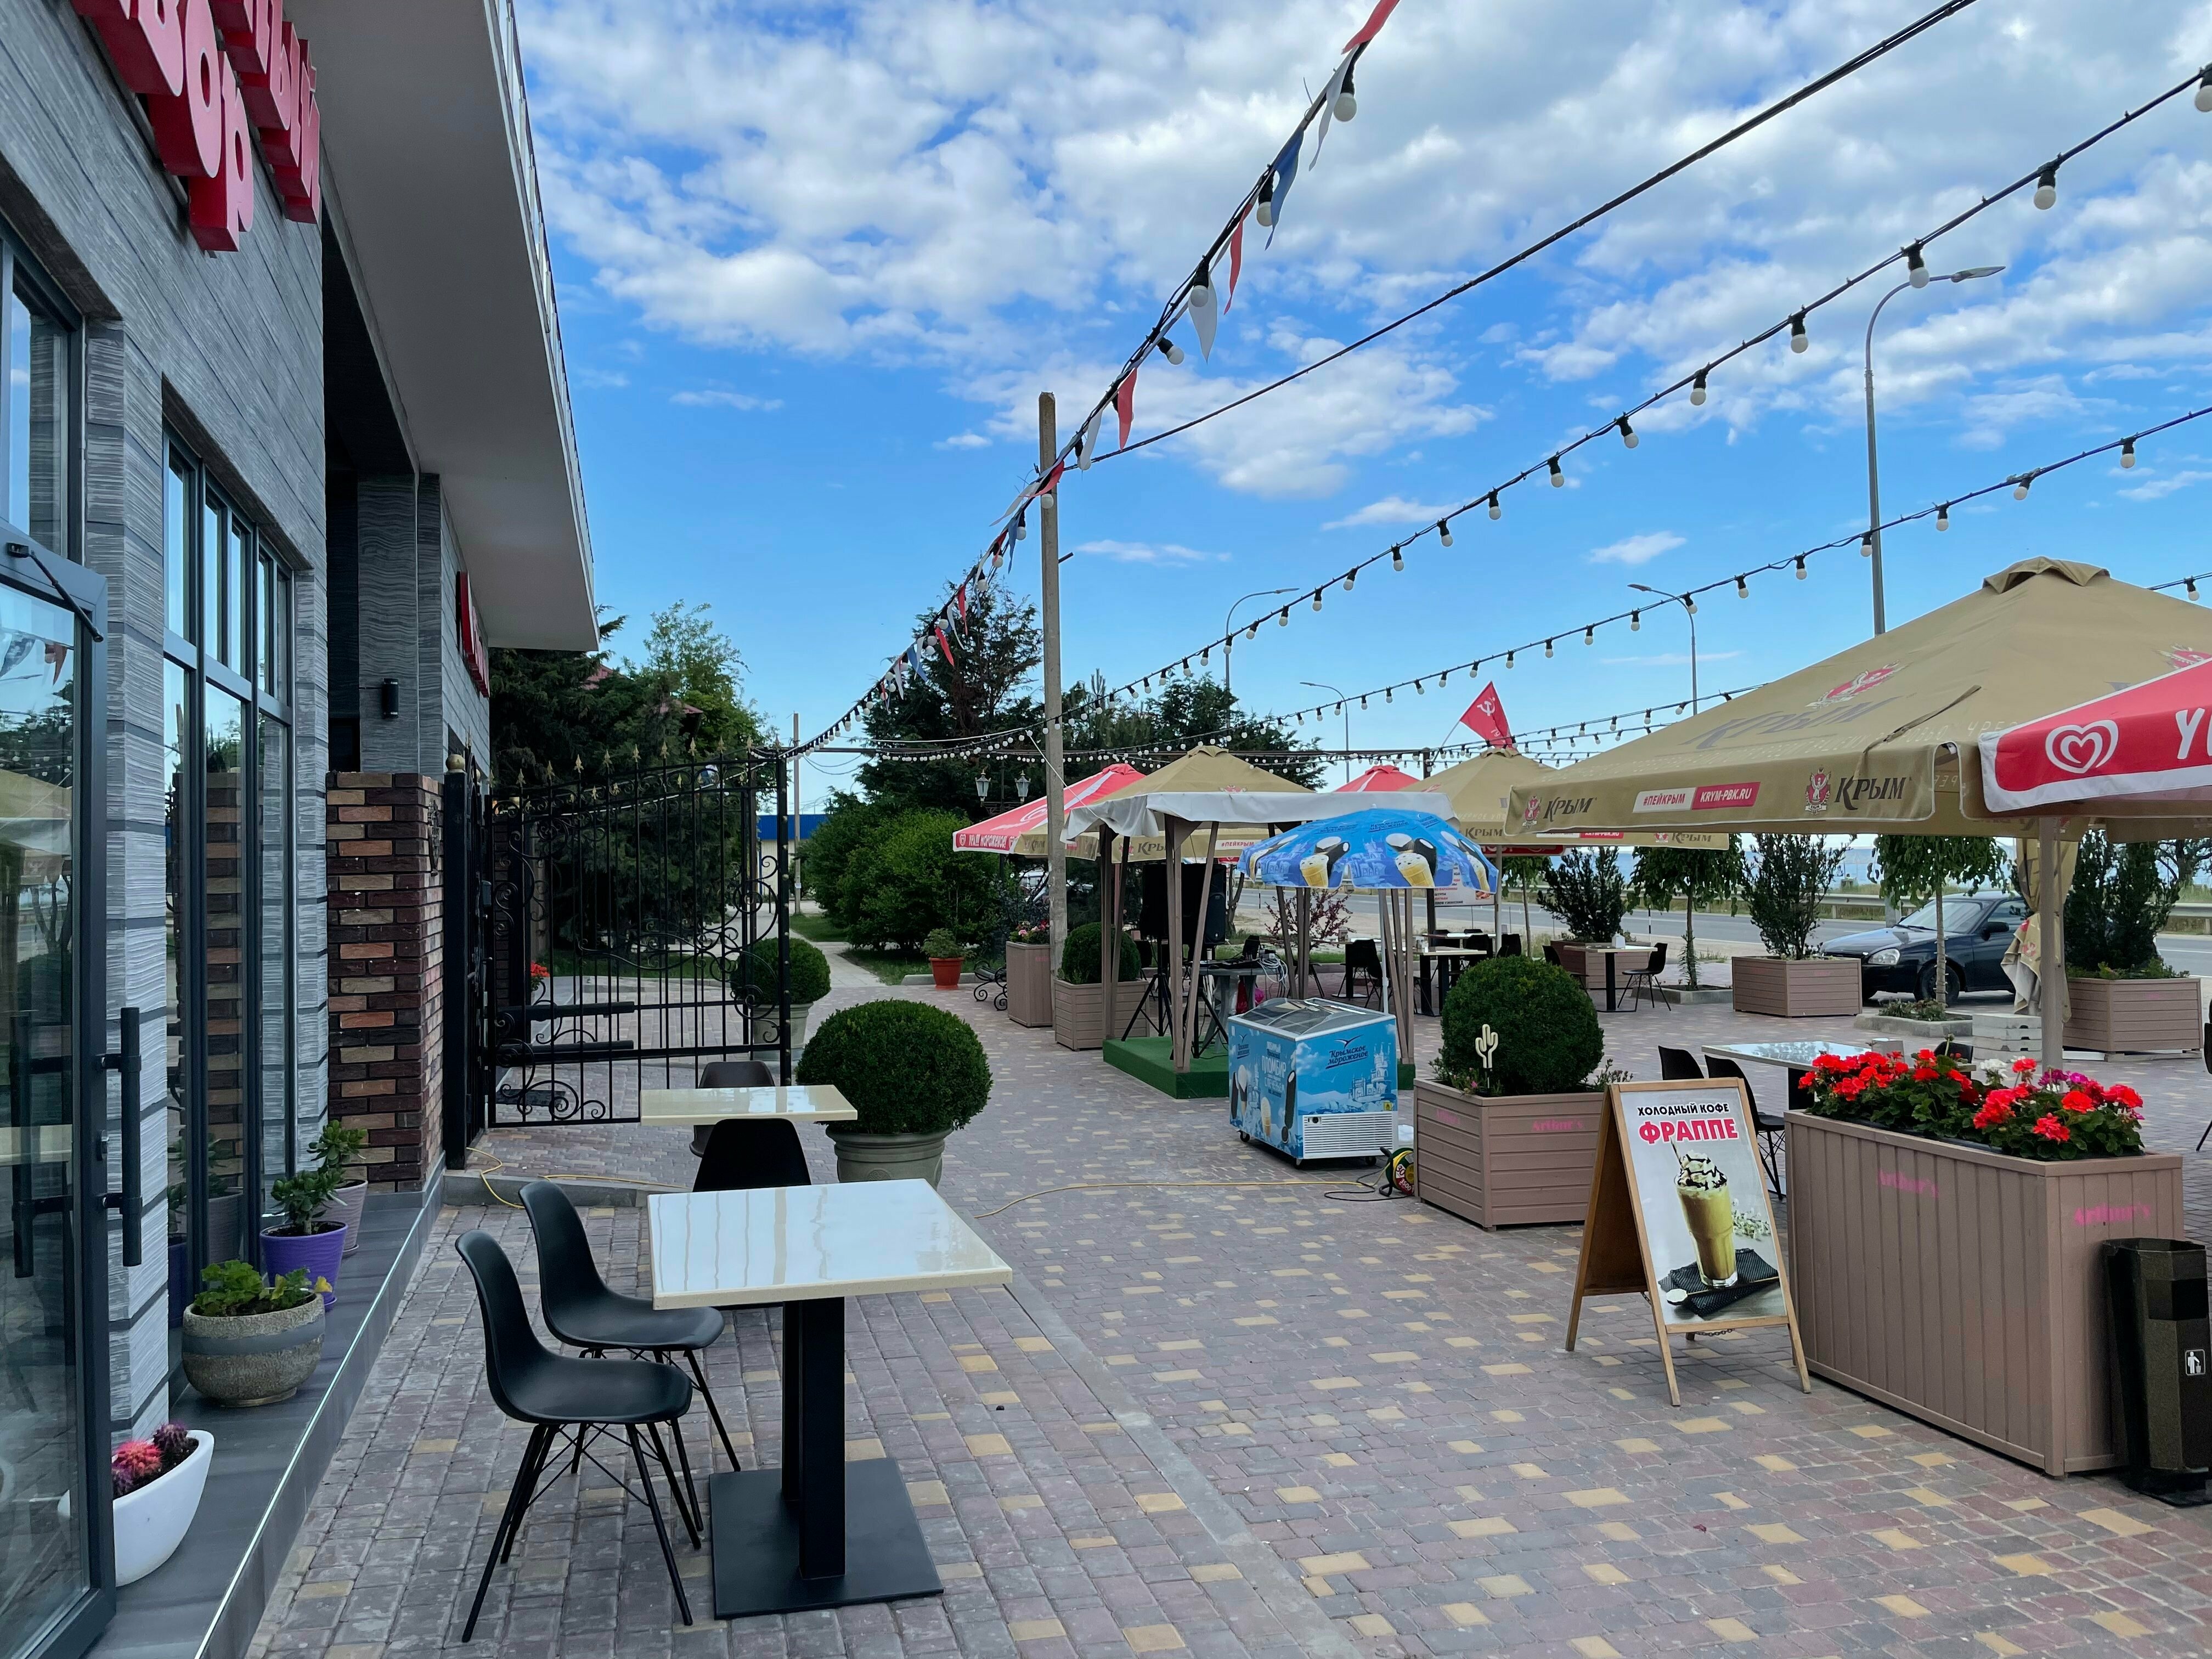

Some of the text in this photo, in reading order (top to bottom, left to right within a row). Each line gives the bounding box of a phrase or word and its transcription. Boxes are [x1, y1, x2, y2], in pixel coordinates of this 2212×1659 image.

[1643, 793, 1686, 806] #ПЕЙКРЫМ
[1700, 788, 1753, 803] KRYM-PBK.RU
[1328, 1051, 1369, 1065] мороженое
[1329, 1045, 1366, 1059] Крымское
[1262, 1055, 1287, 1079] ПЛОМБИР
[1637, 1103, 1729, 1116] ХОЛОДНЫЙ КОФЕ
[1639, 1119, 1738, 1144] ФРАППЕ
